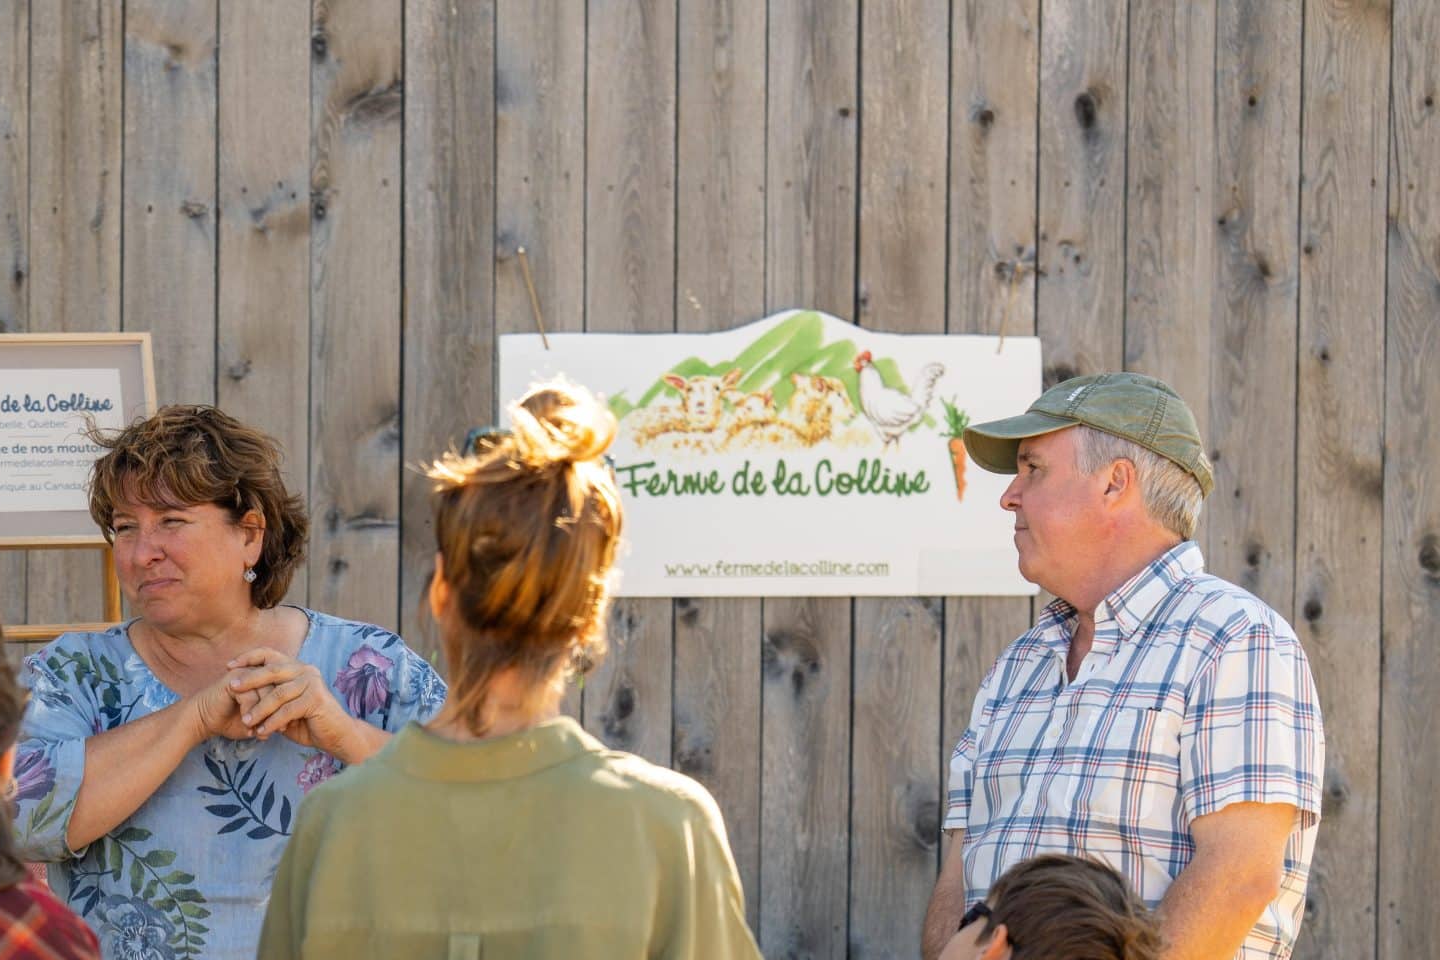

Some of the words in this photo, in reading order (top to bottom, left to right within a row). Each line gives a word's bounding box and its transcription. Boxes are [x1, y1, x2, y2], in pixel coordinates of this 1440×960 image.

[0, 394, 20, 413] de
[23, 394, 45, 413] la
[47, 392, 113, 412] Colline
[12, 444, 27, 454] de
[31, 445, 53, 454] nos
[57, 444, 106, 453] mouto
[29, 483, 41, 491] au
[43, 480, 82, 491] Canada
[616, 461, 724, 497] Ferme
[732, 460, 766, 496] de
[772, 459, 810, 496] la
[815, 458, 930, 498] Colline
[664, 560, 889, 576] www.fermedelacolline.com
